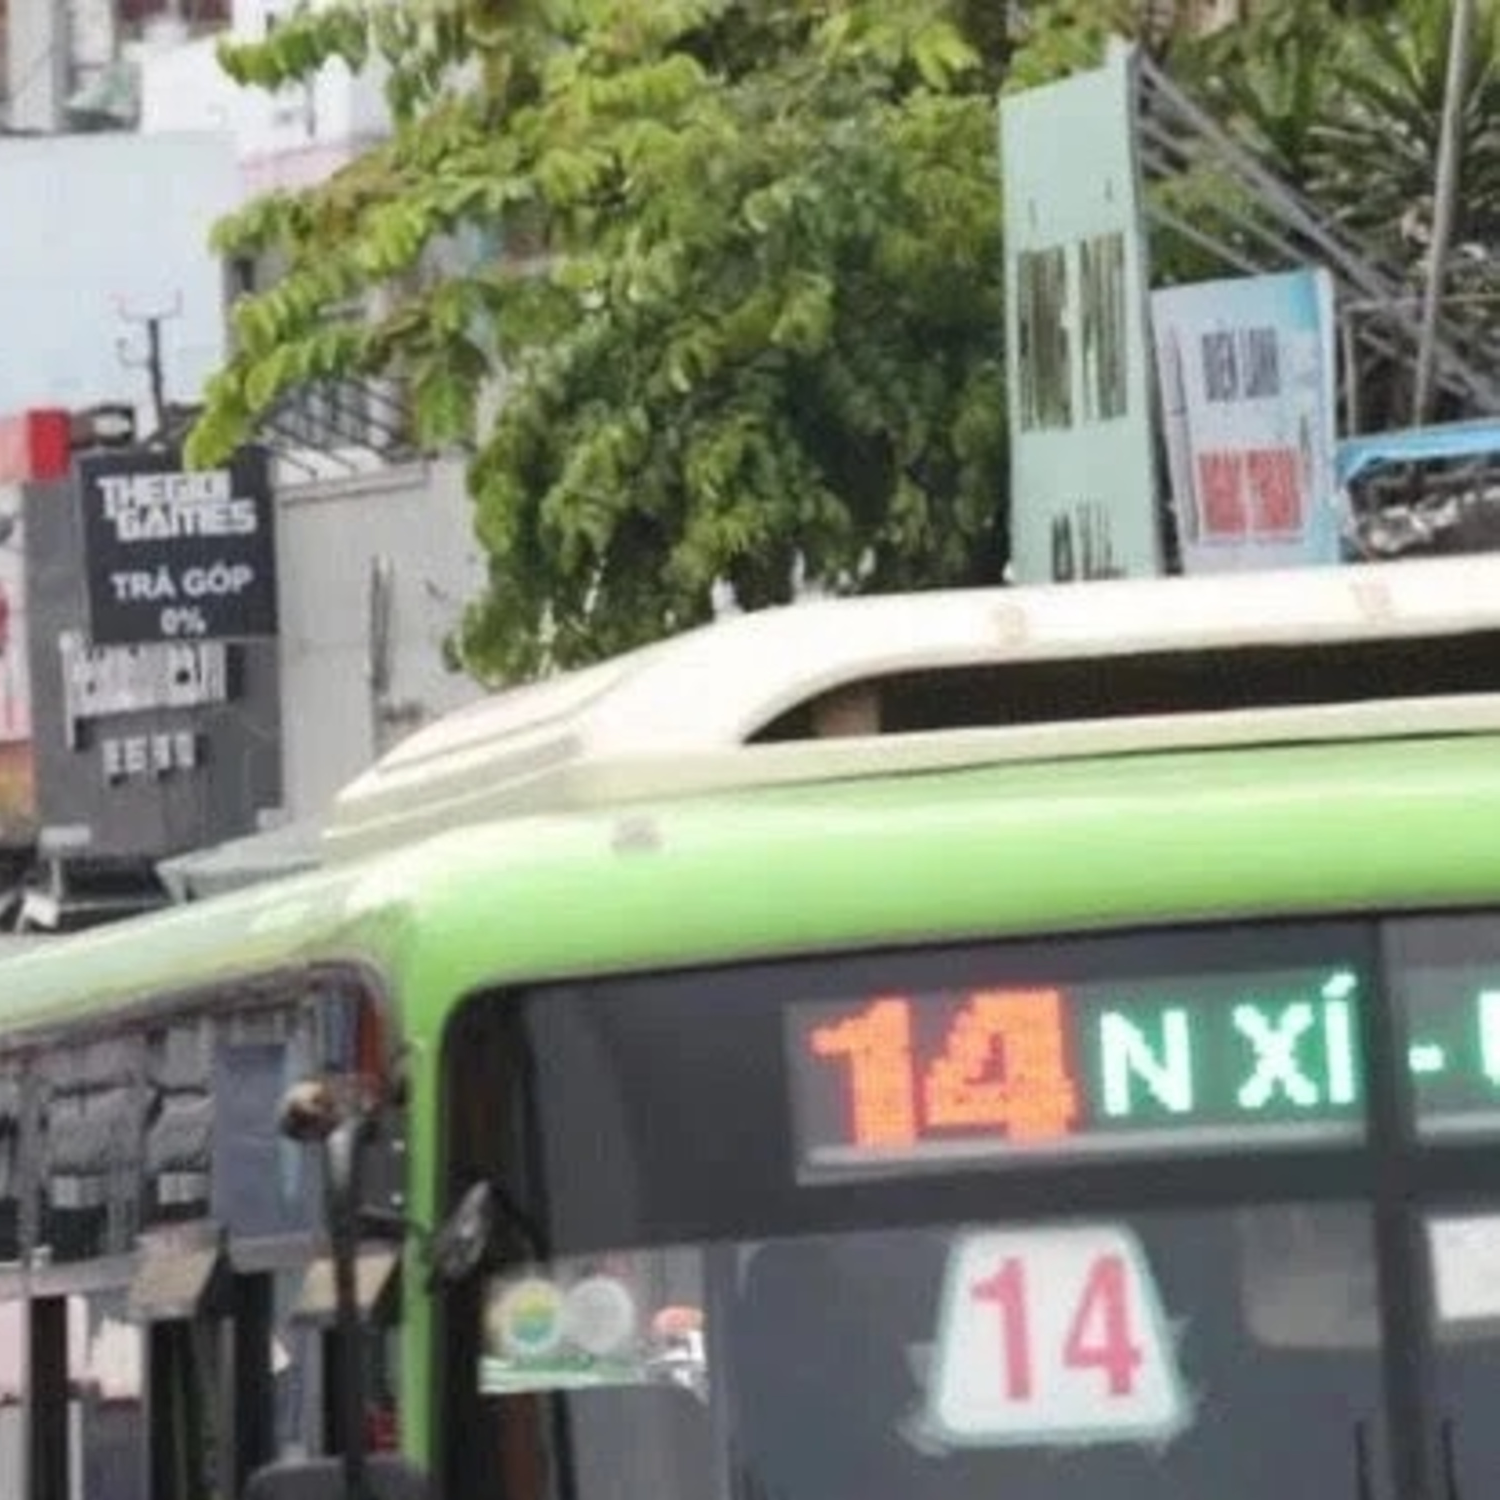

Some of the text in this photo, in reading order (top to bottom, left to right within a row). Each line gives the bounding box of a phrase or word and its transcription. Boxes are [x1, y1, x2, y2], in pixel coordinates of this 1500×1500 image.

[810, 988, 1080, 1148] 14
[1099, 1008, 1193, 1116] N
[1233, 970, 1358, 1110] XÍ
[969, 1253, 1143, 1401] 14
